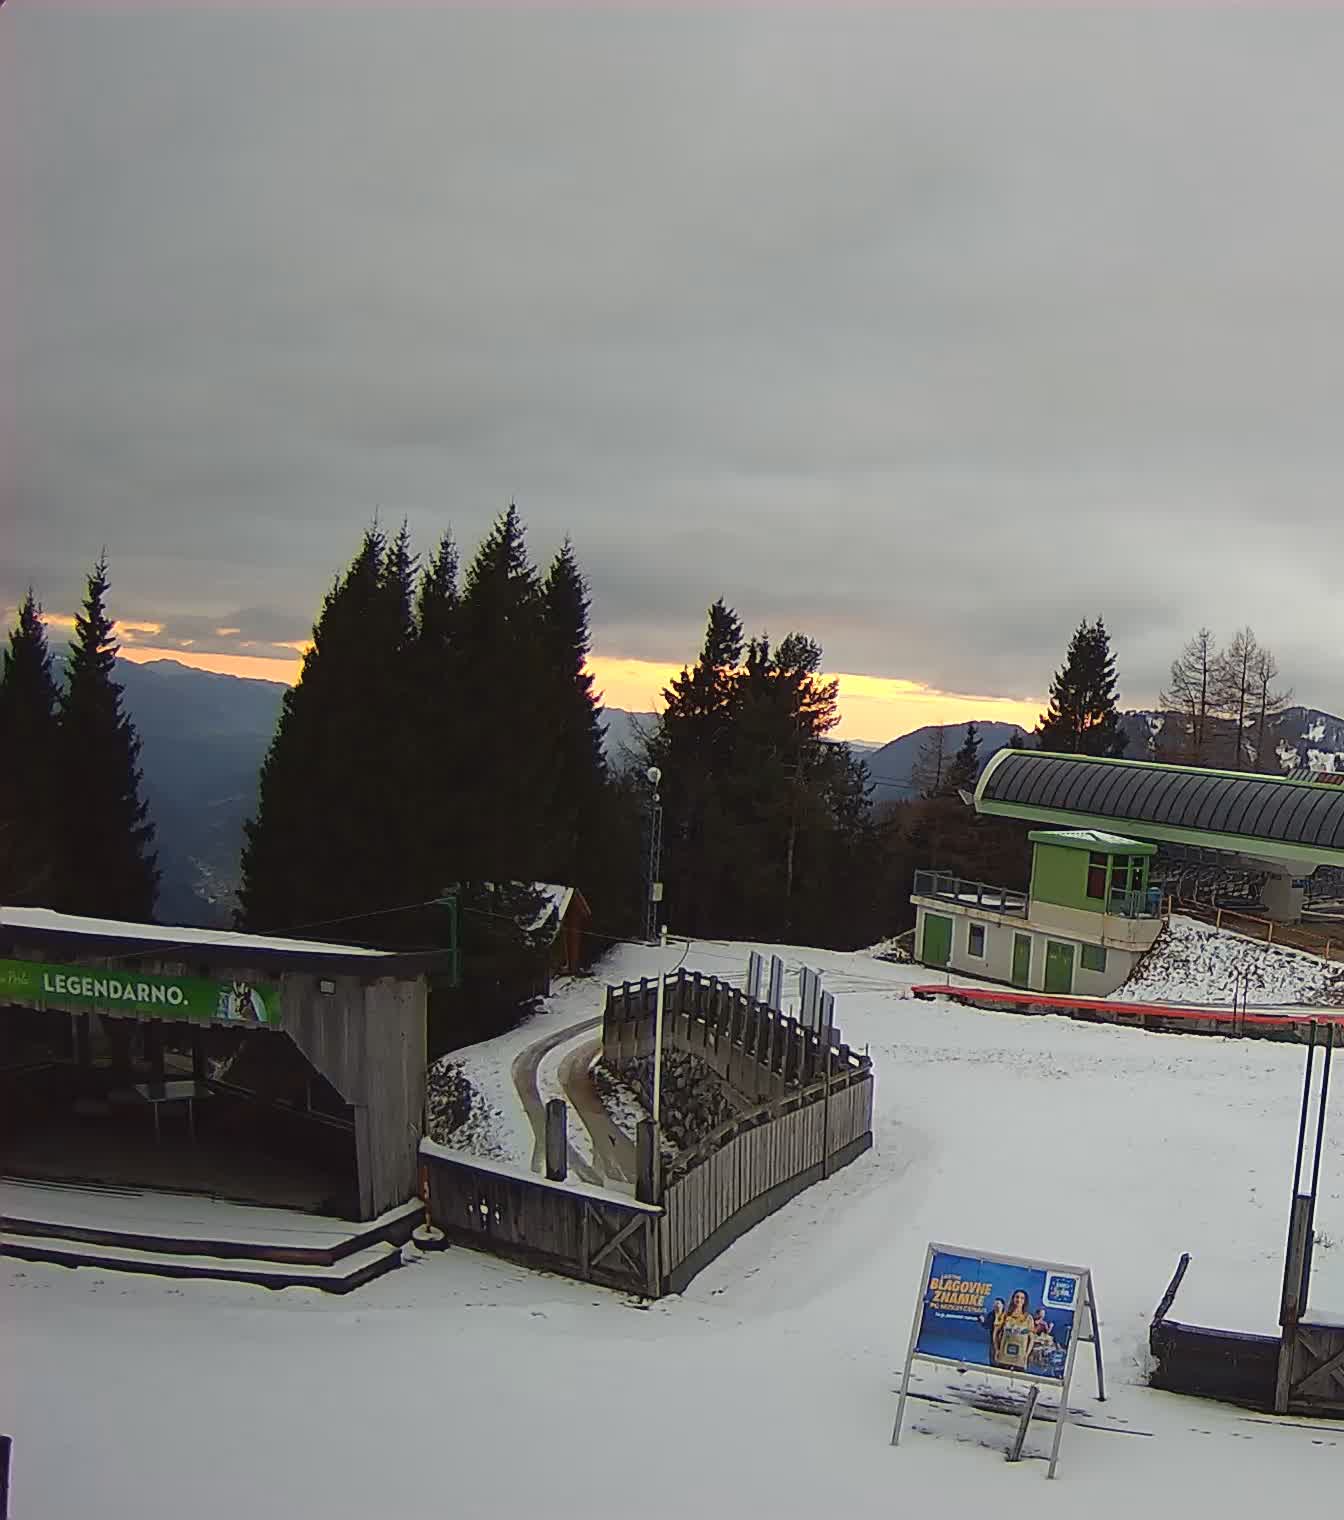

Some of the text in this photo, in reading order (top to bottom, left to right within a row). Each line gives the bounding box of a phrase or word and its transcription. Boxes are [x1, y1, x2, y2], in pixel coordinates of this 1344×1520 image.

[43, 972, 189, 1006] LEGENDARNO.
[930, 1278, 992, 1297] BLAGOVNE
[932, 1290, 985, 1307] ZNAMKE
